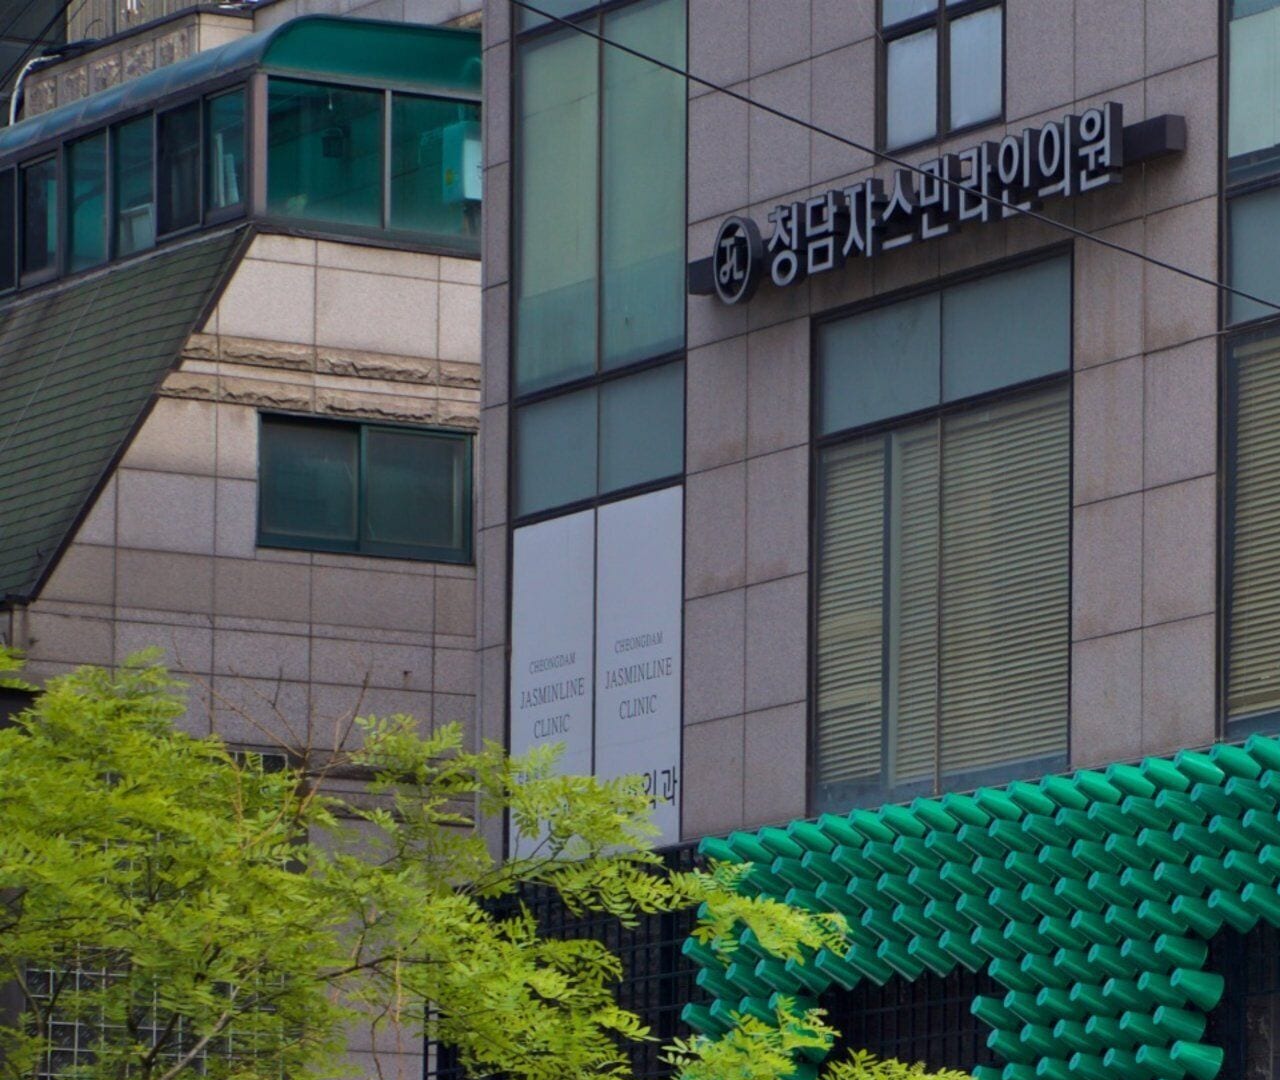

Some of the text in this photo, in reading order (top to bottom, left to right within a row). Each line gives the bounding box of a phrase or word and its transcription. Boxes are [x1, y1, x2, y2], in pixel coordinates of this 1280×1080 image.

[768, 103, 1114, 287] 청담쟈스민라인의원
[614, 631, 663, 654] CHEONGDAM
[529, 652, 576, 674] CHEONGDAM
[605, 657, 673, 689] JASMINLINE
[520, 677, 585, 710] JASMINLINE
[619, 695, 657, 720] CLINIC
[534, 714, 571, 739] CLINIC
